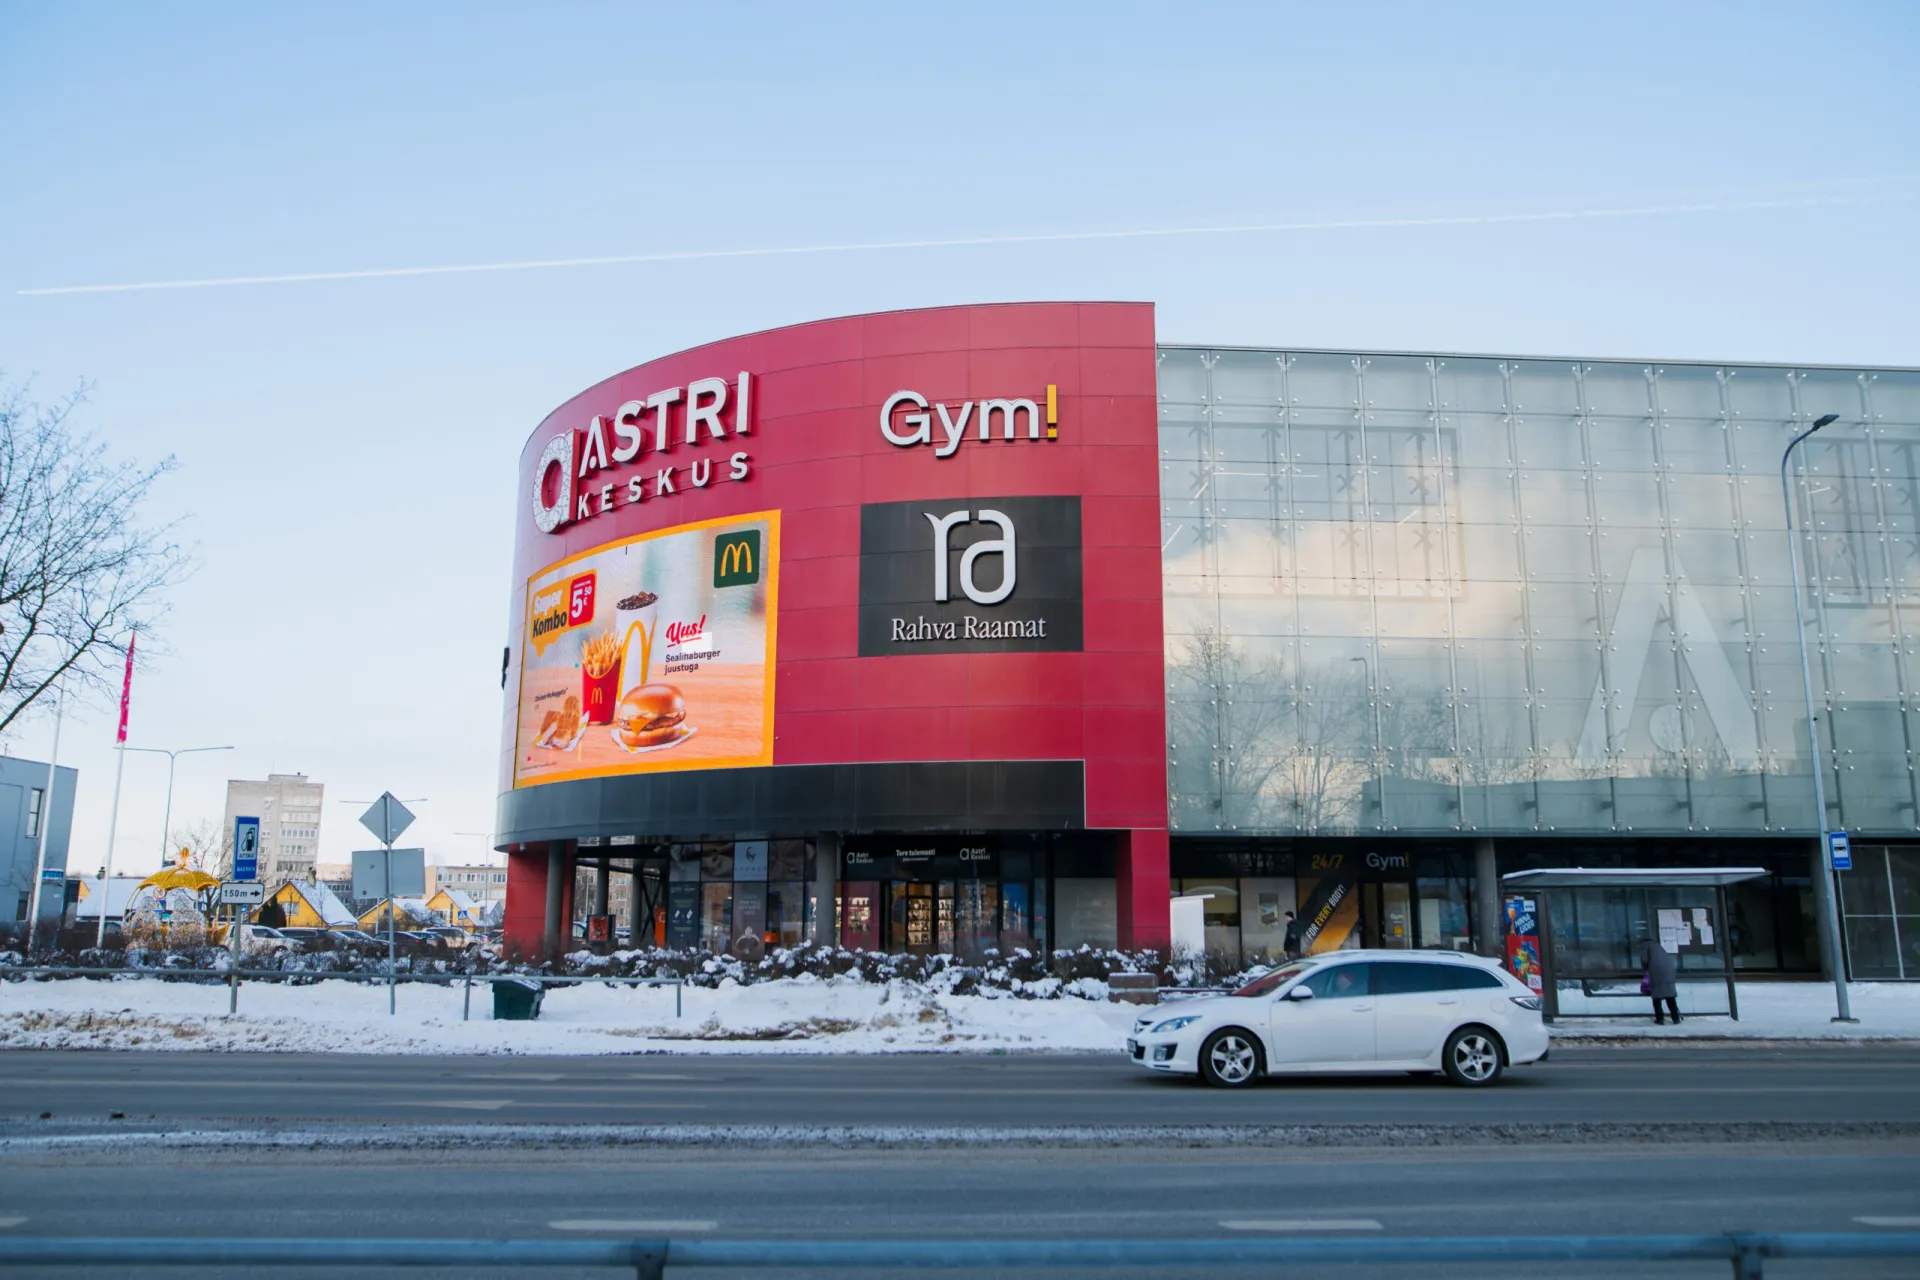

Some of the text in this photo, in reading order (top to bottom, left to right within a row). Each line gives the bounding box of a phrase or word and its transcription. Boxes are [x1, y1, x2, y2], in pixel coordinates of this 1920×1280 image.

[578, 371, 753, 478] ASTRI
[880, 384, 1057, 457] Gym!
[577, 452, 750, 520] KESKUS
[534, 588, 563, 616] Super
[532, 609, 568, 638] Kombo
[665, 614, 706, 645] Uus!
[891, 615, 1047, 641] Rahva Raamat
[664, 663, 699, 676] juustuga
[665, 650, 721, 662] Sealihaburger
[1312, 853, 1344, 869] 24/7
[1366, 852, 1410, 870] Gym!
[224, 889, 248, 897] 150m
[1305, 883, 1348, 940] FOR EVERY BODY!
